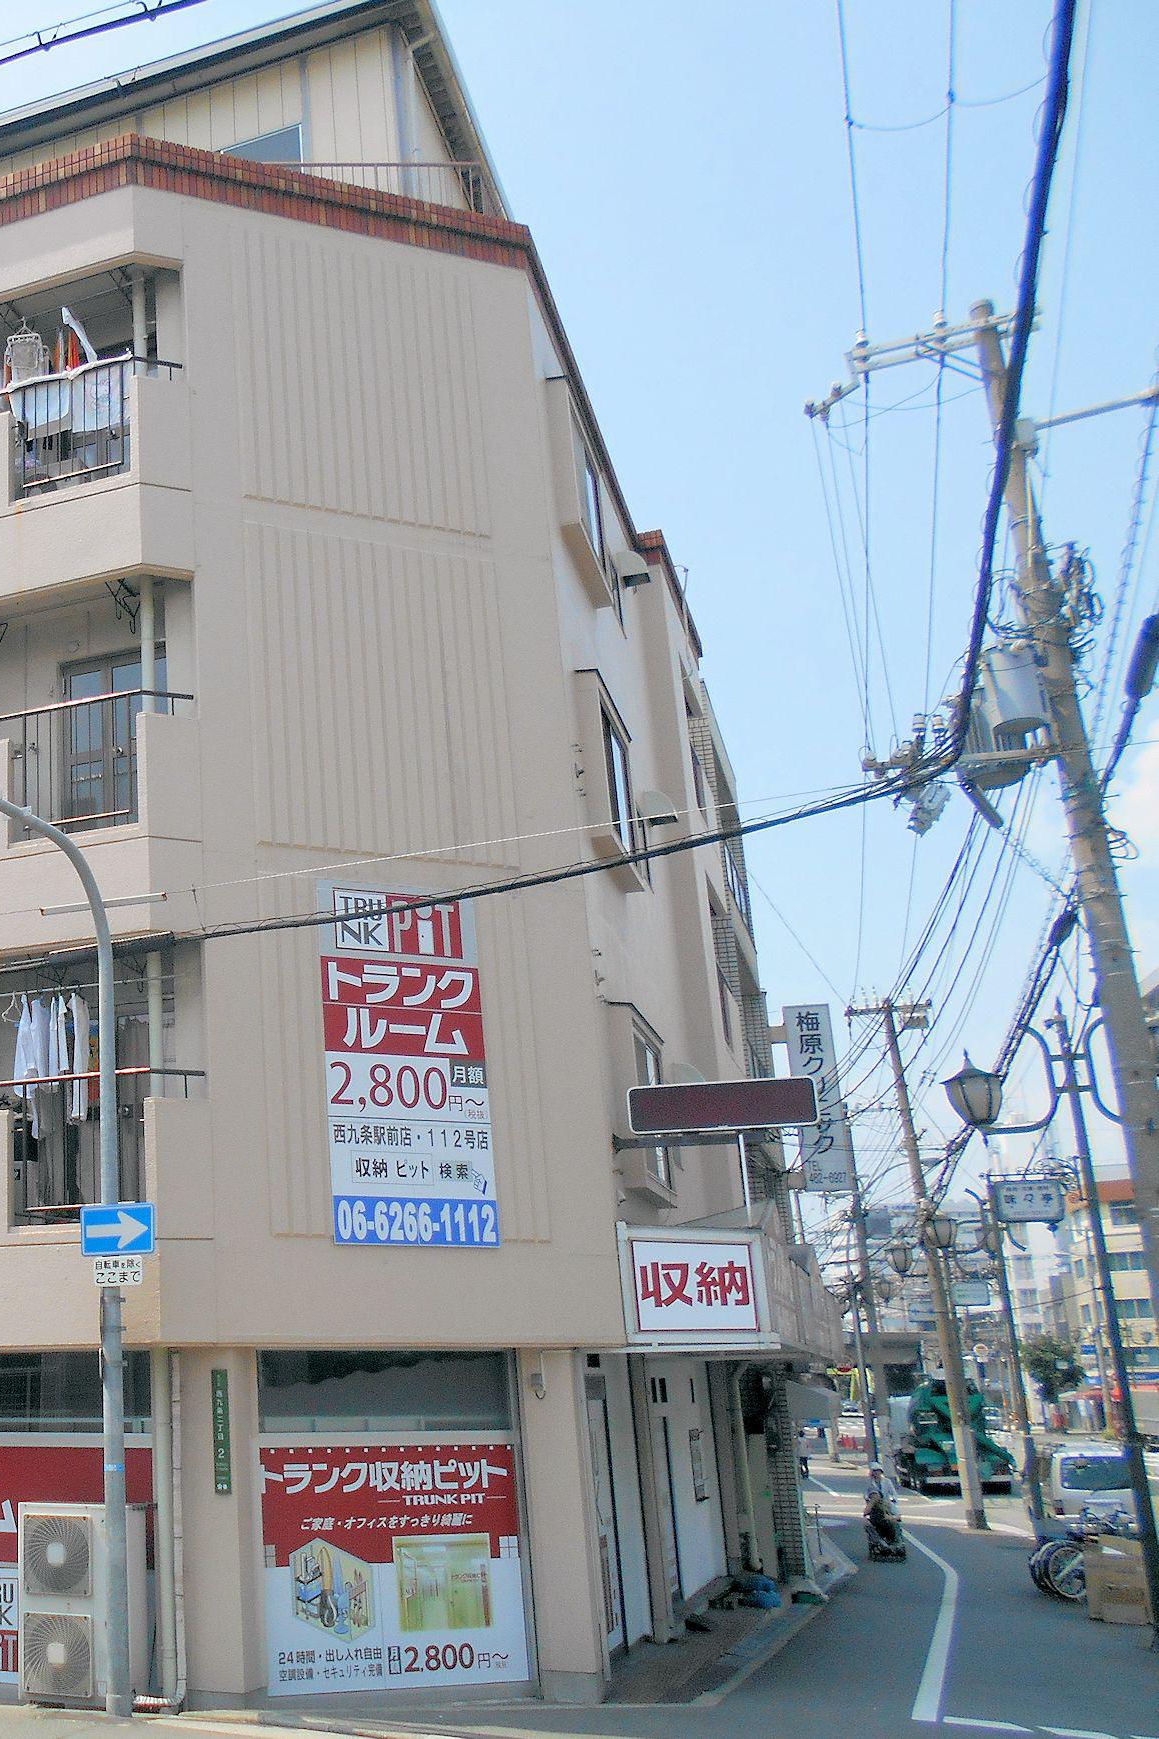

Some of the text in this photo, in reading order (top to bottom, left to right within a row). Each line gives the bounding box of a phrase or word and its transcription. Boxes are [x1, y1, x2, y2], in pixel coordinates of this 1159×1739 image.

[327, 961, 473, 1008] トランク
[342, 1007, 469, 1055] ルーム
[452, 1065, 484, 1084] 月額
[439, 1163, 469, 1180] 検索
[337, 1199, 497, 1243] 06-6266-1112
[95, 1258, 141, 1270] 自転車を除く
[96, 1270, 140, 1284] ここまで
[639, 1260, 750, 1308] 収納
[217, 1448, 225, 1459] 2
[261, 1458, 508, 1495] トランク収納ピット
[402, 1492, 485, 1506] TRUNK PIT
[300, 1513, 473, 1531] ご家庭・オフィスをすっきり綺麗に
[278, 1648, 383, 1665] 24時間・出し入れ自由
